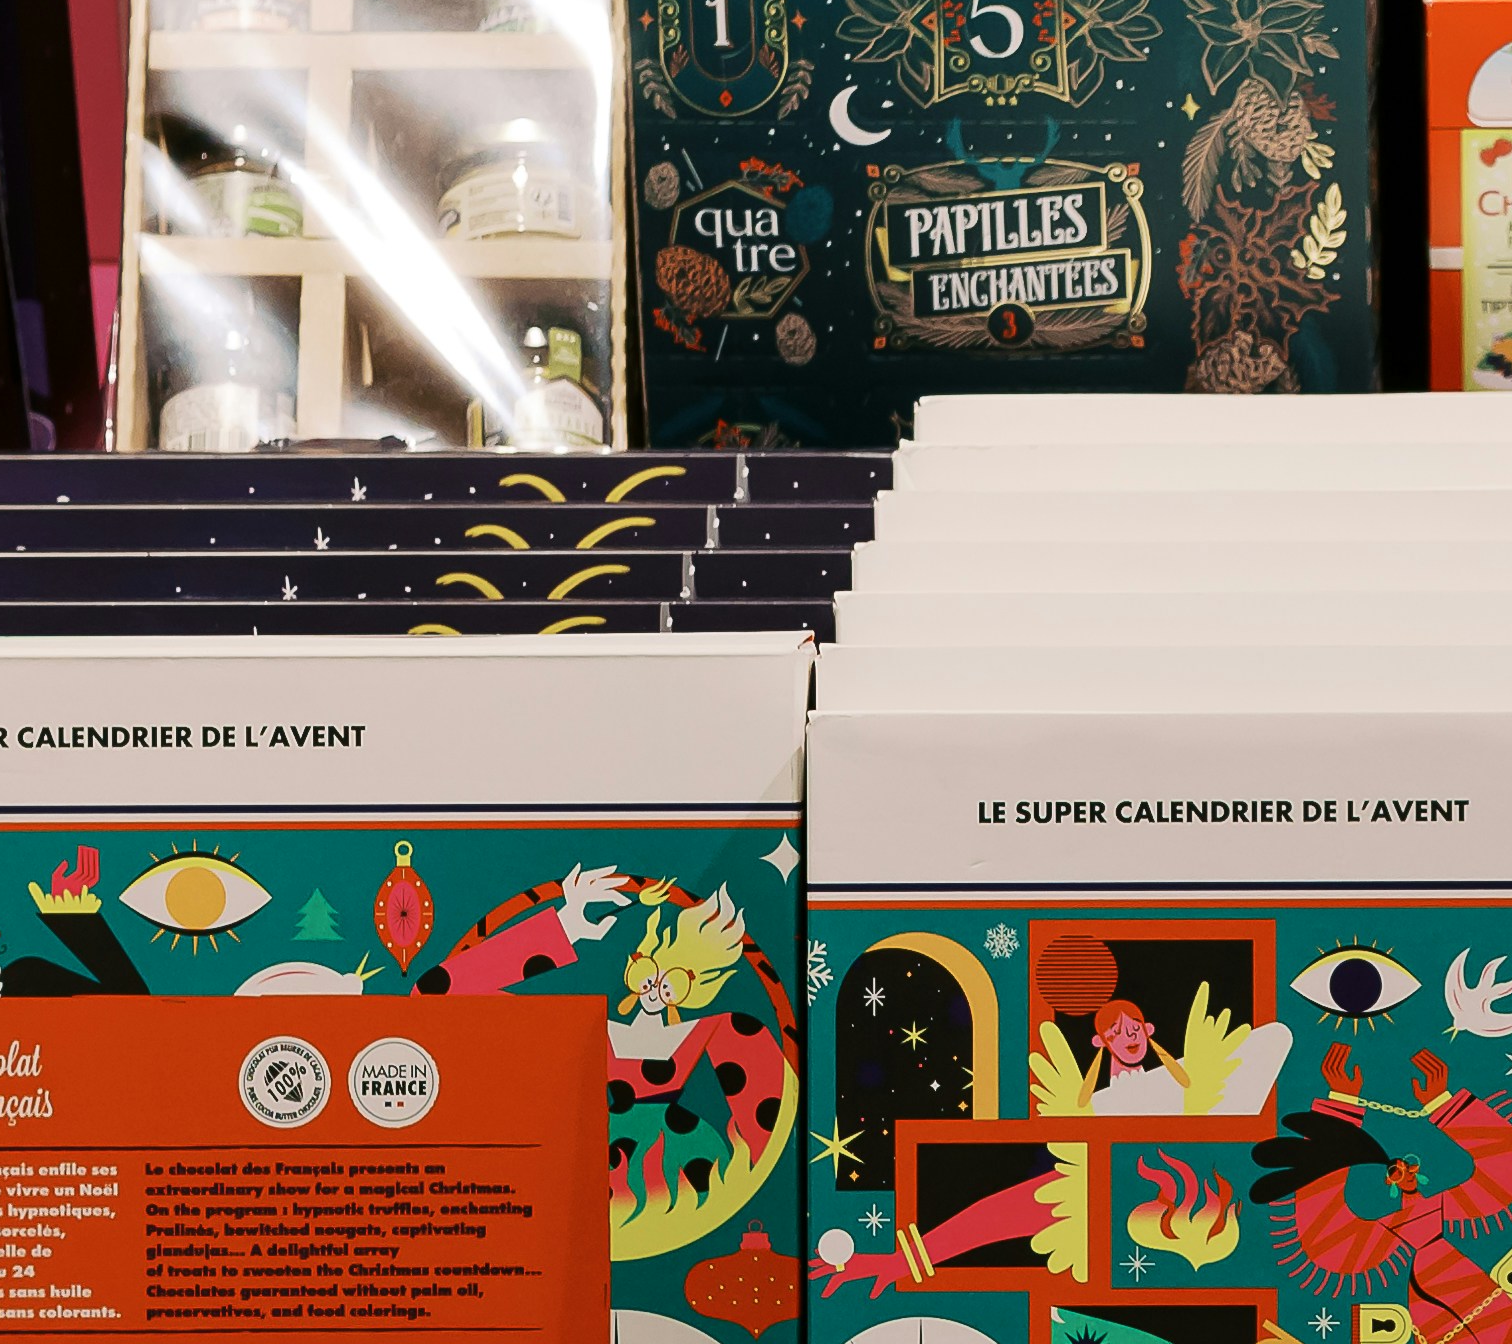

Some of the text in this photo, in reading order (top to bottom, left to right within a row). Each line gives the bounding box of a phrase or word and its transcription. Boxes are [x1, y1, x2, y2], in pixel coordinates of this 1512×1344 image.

[904, 193, 1088, 258] PAPILLES
[1000, 310, 1018, 340] 3
[17, 726, 193, 749] CALENDRIER
[202, 726, 236, 748] DE
[246, 725, 366, 748] L'AVENT
[979, 799, 1470, 824] LE SUPER CALENDRIER DE L'AVENT
[267, 1061, 307, 1103] 100%
[362, 1064, 427, 1079] MADE IN
[361, 1080, 428, 1096] FRANCE
[38, 1162, 87, 1177] enfile
[92, 1166, 118, 1176] ses
